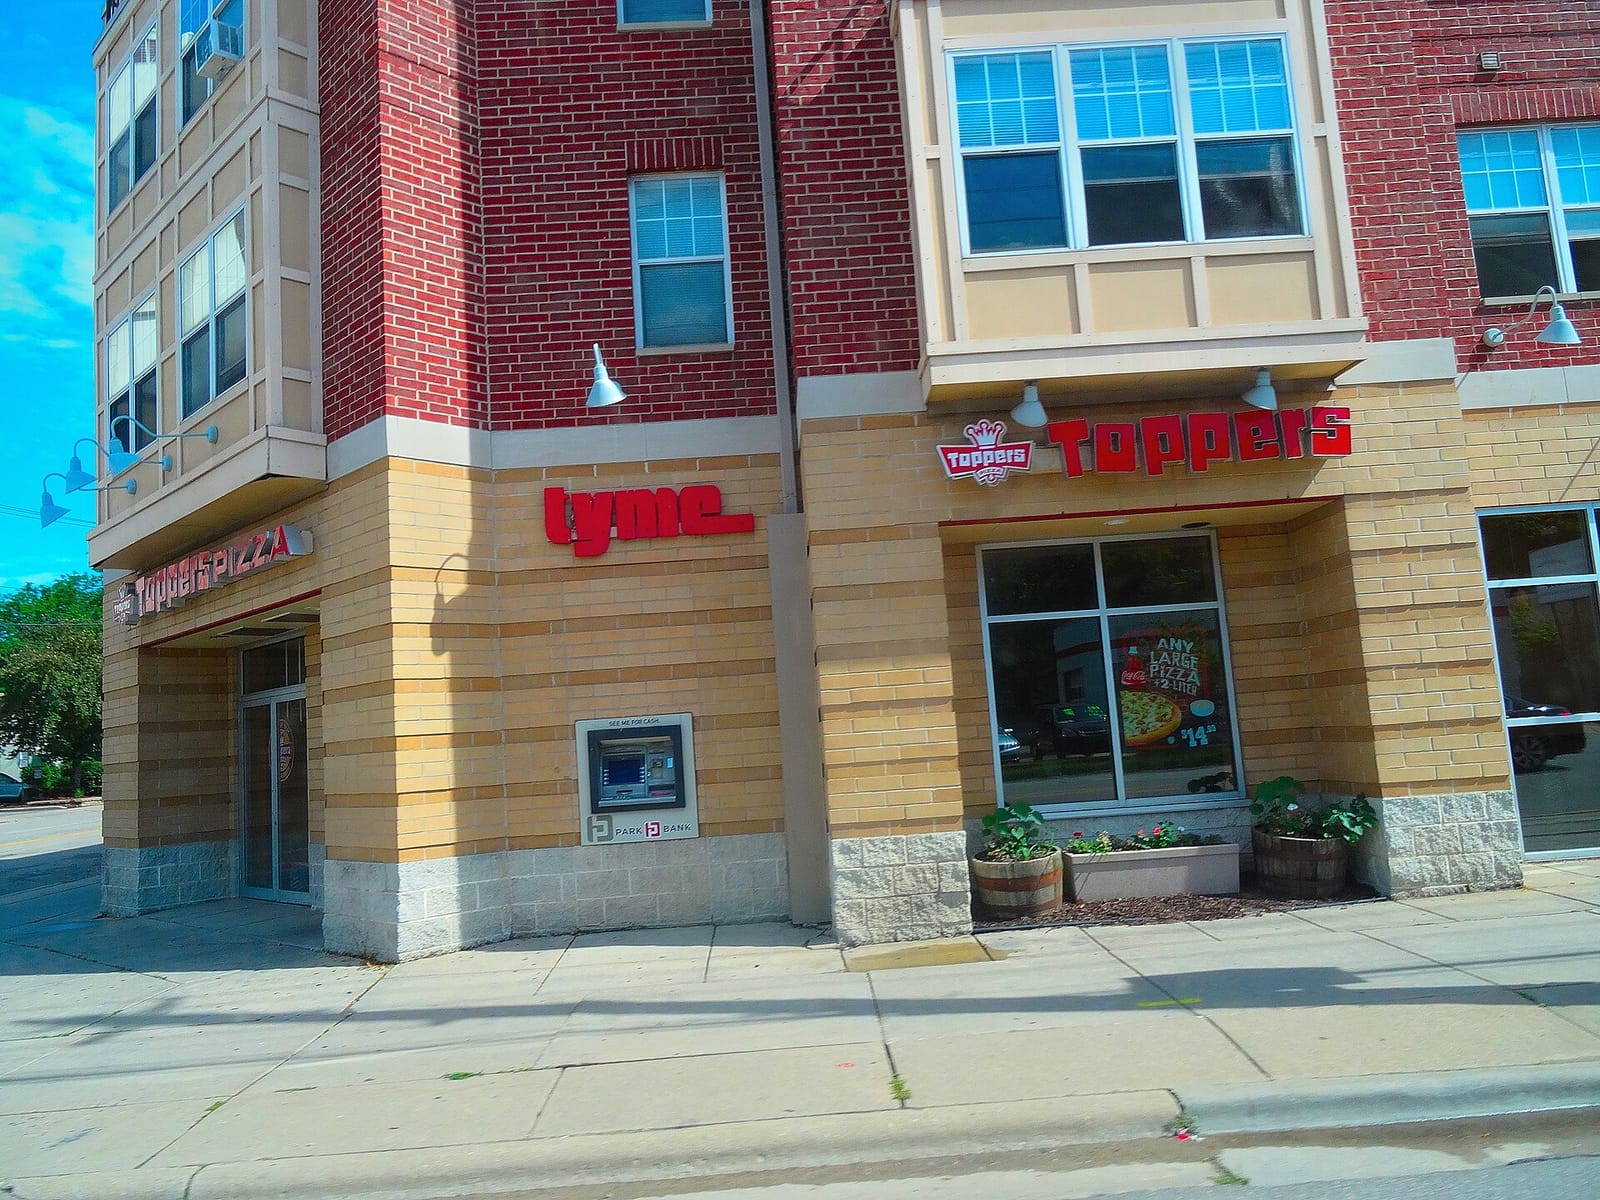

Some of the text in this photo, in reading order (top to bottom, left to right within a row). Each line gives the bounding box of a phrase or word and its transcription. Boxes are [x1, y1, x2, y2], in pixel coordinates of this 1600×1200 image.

[1048, 407, 1351, 478] Toppers
[947, 449, 1026, 467] Toppers
[544, 485, 755, 557] tyme
[135, 525, 291, 617] Toppers PIZZA
[1157, 638, 1194, 653] ANY
[1150, 651, 1199, 671] LARGE
[615, 823, 692, 836] PARK BANK
